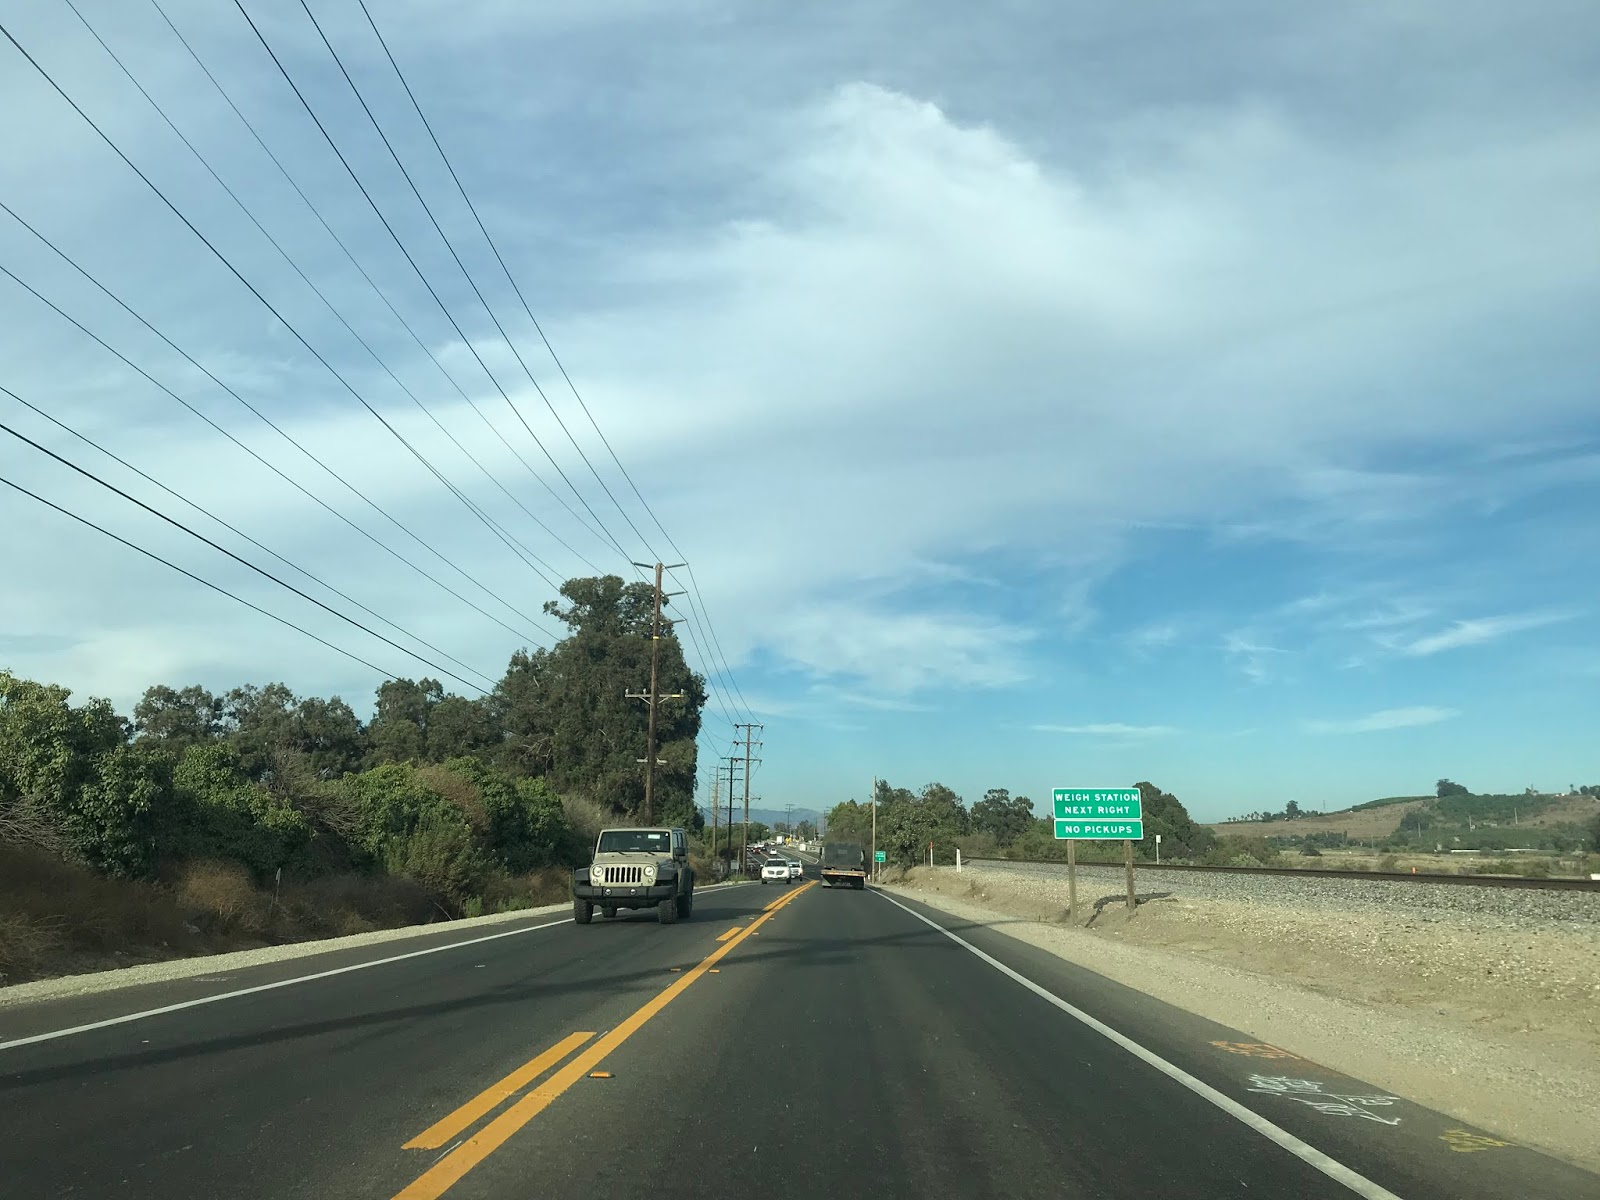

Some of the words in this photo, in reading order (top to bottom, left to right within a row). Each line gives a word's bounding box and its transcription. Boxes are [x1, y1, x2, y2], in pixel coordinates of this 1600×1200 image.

[1055, 793, 1090, 802] WEIGH
[1094, 793, 1138, 802] STATION
[1064, 806, 1093, 814] NEXT
[1097, 806, 1130, 814] RIGHT
[1065, 825, 1080, 834] NO
[1084, 825, 1133, 834] PICKUPS
